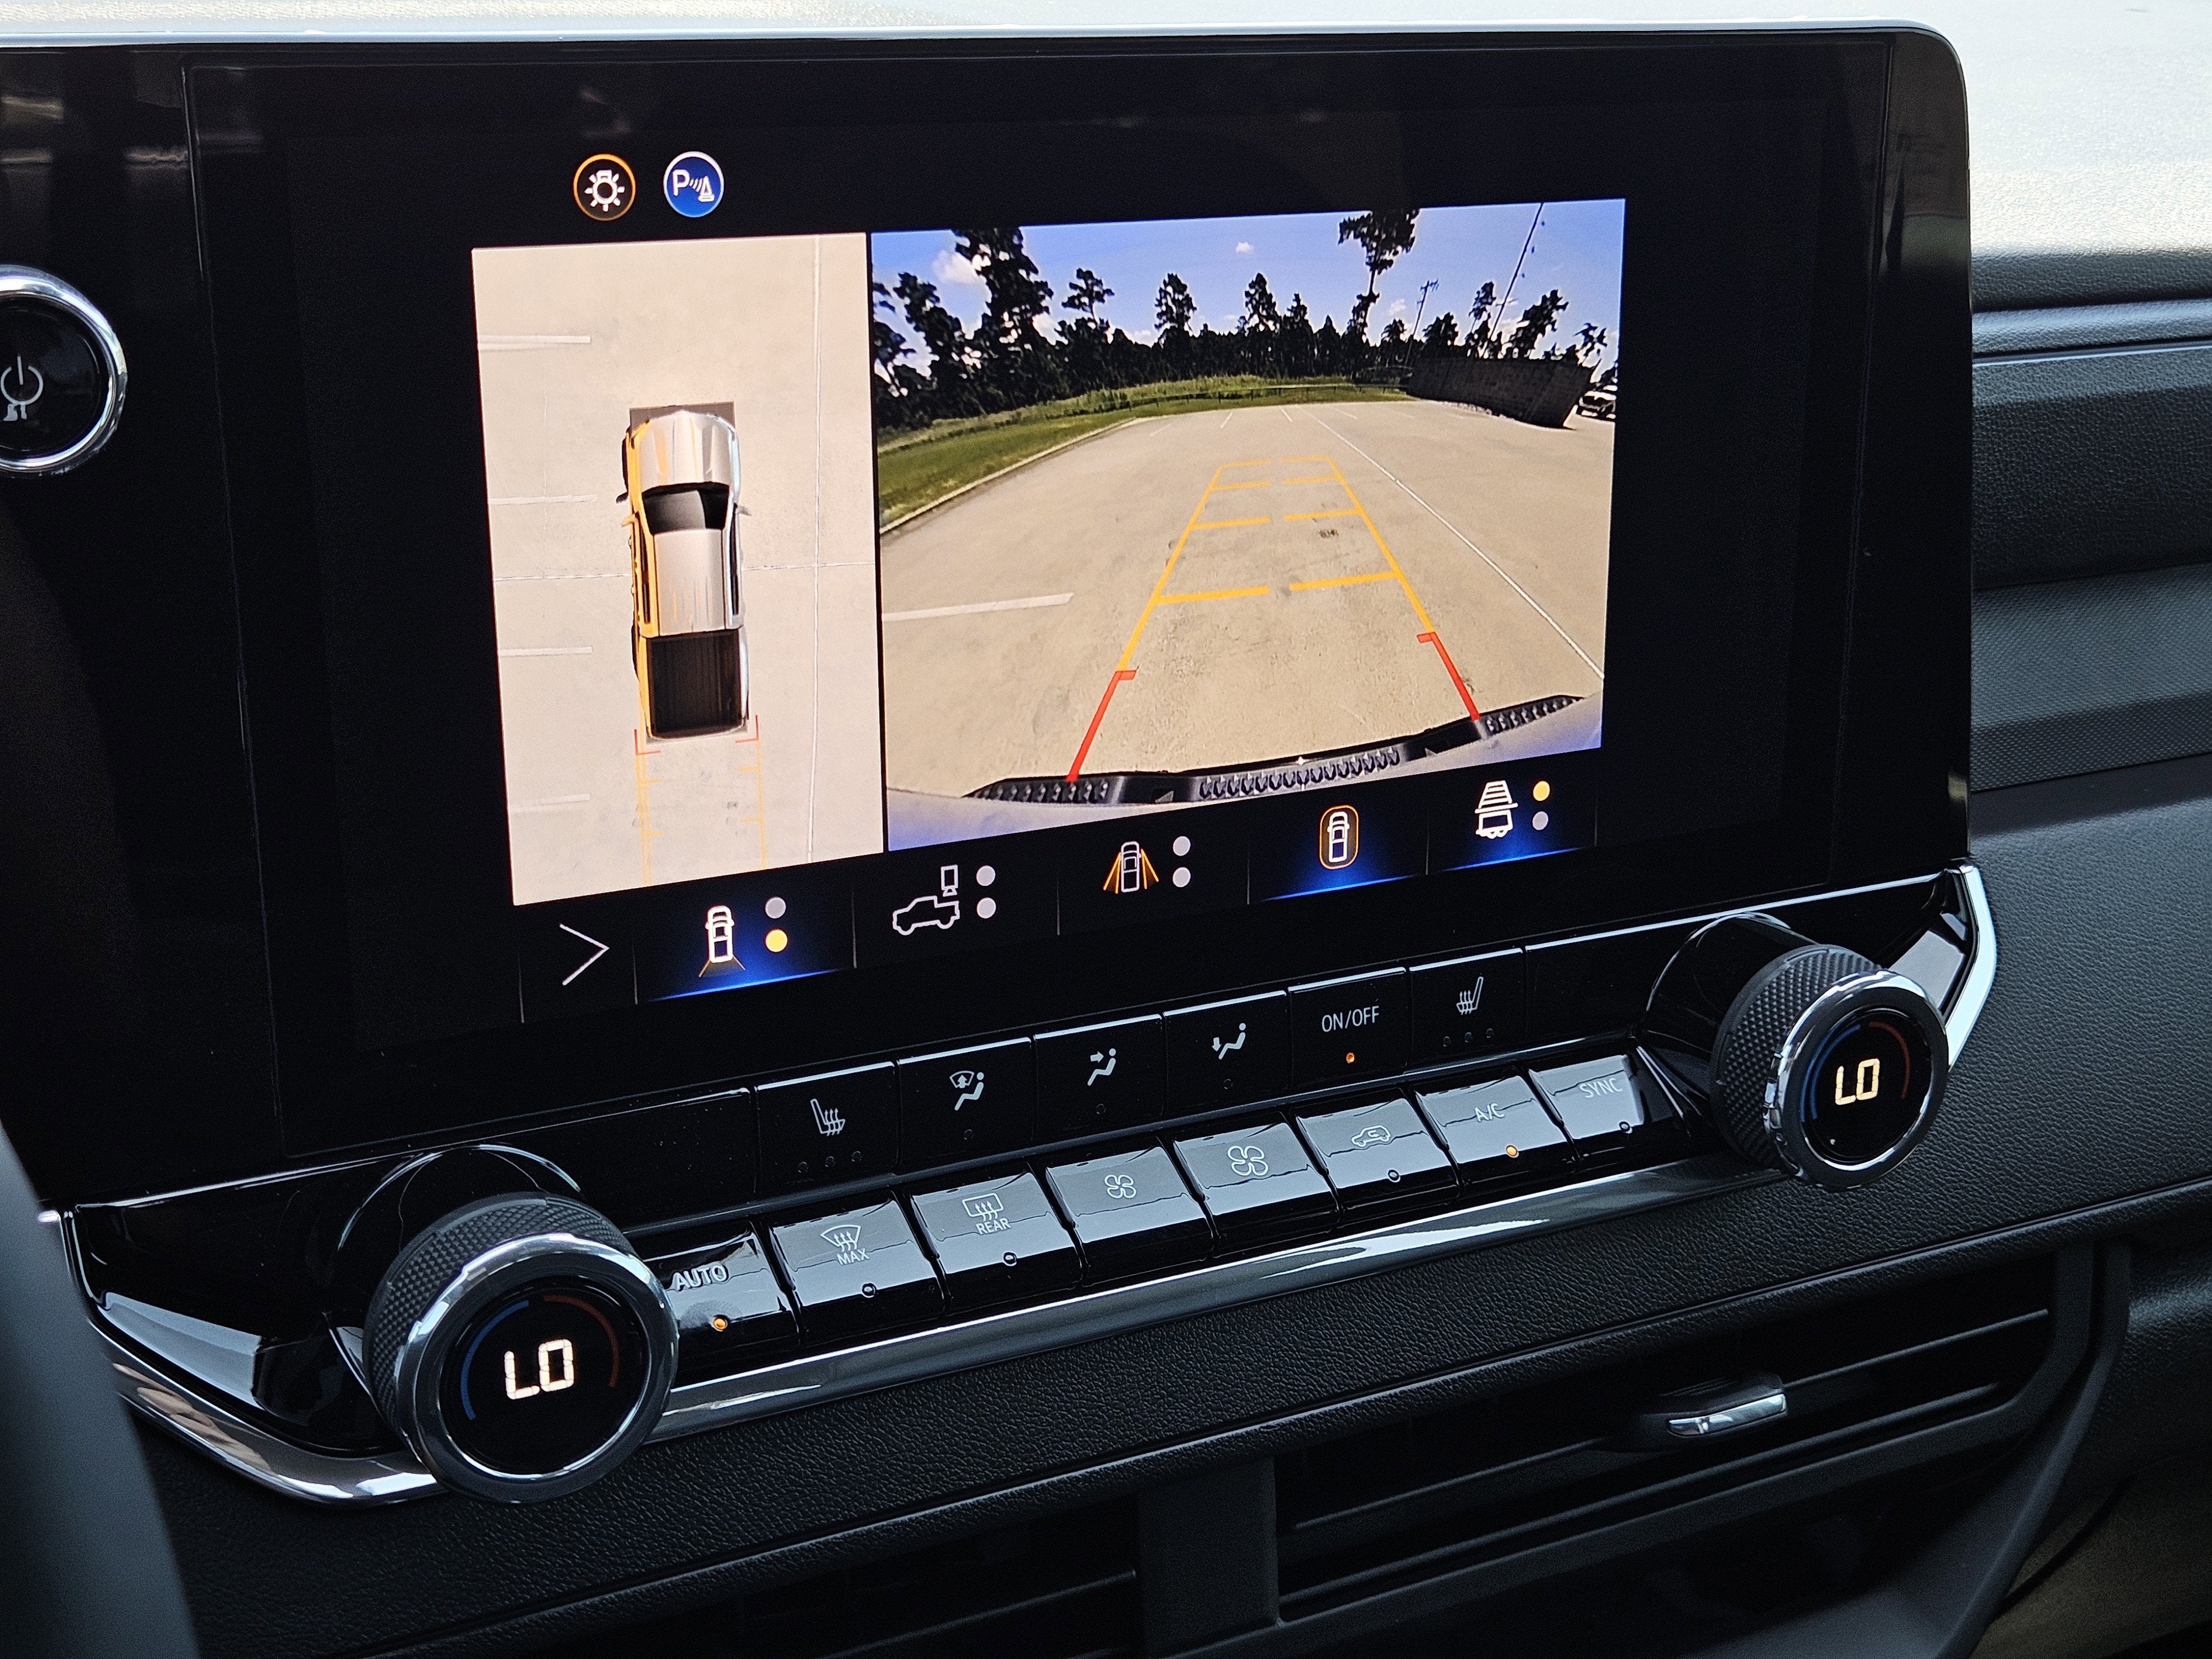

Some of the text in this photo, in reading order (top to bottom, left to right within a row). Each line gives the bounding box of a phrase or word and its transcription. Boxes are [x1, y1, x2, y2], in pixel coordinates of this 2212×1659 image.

[1322, 1005, 1379, 1032] ON/OFF
[1579, 1078, 1623, 1098] SYNC
[1835, 1058, 1880, 1105] LO
[1474, 1103, 1505, 1123] A/C
[975, 1217, 1011, 1235] REAR
[836, 1248, 870, 1265] MAX
[672, 1263, 728, 1291] AUTO
[504, 1339, 575, 1400] LO
